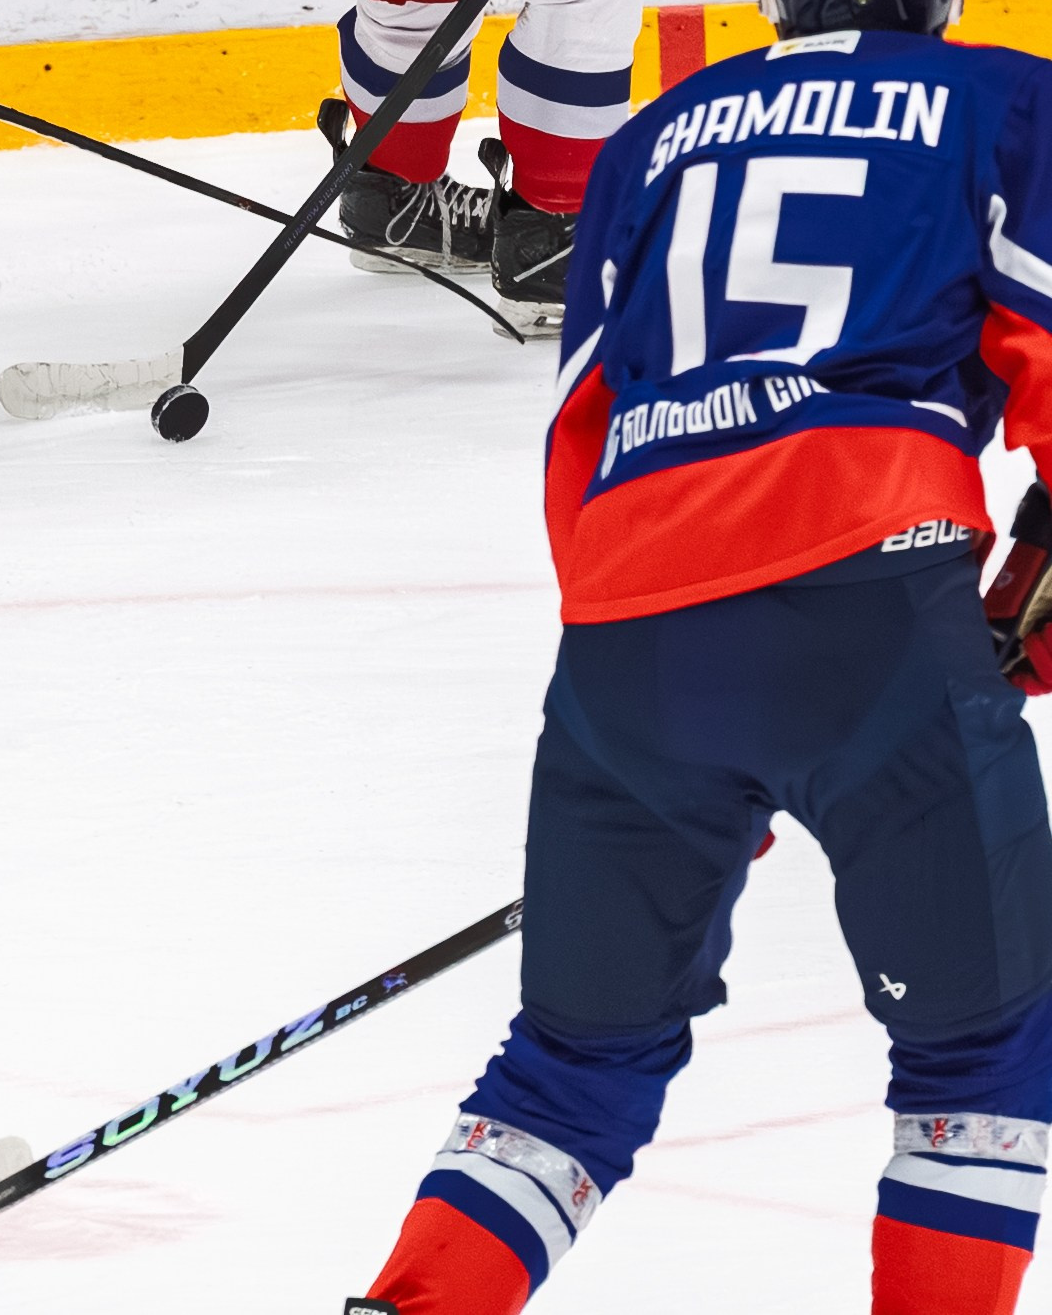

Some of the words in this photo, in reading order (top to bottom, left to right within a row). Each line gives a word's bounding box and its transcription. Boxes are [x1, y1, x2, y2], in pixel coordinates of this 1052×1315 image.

[644, 80, 950, 188] SHAMOLIN
[666, 156, 869, 377] 15
[44, 1002, 329, 1179] SOYUZ
